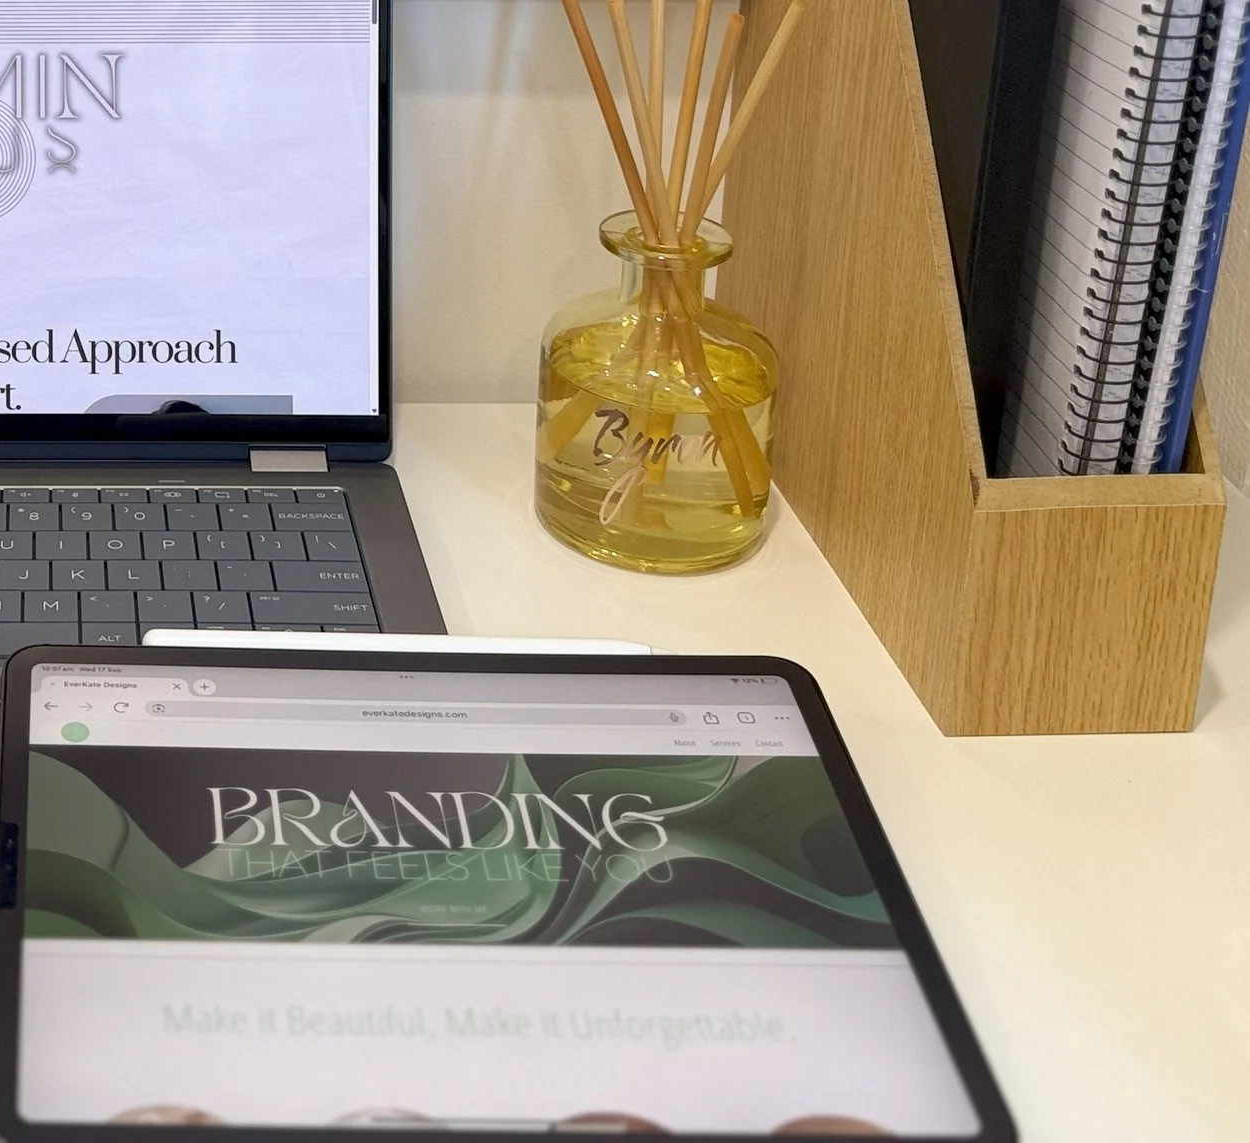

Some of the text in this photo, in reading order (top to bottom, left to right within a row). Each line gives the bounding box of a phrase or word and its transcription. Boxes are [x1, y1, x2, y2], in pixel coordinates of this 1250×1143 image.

[59, 328, 239, 375] Approach
[592, 408, 722, 525] Byron
[28, 512, 40, 521] 8
[81, 511, 93, 521] 9
[133, 511, 146, 521] 0
[0, 540, 14, 550] U
[107, 539, 124, 550] O
[162, 539, 175, 549] P
[18, 569, 29, 580] J
[71, 569, 85, 580] K
[128, 569, 140, 580] L
[319, 572, 360, 580] ENTER
[43, 600, 59, 611] M
[97, 634, 121, 642] ALT
[103, 681, 138, 690] Designs
[361, 709, 468, 719] everkatedesigns.com
[673, 738, 696, 747] About
[709, 739, 742, 748] Services
[754, 740, 784, 748] Contact
[206, 786, 669, 852] BRANDING
[213, 848, 675, 884] THAT FEELS LIKE YOU
[161, 1003, 800, 1050] Make it Beautiful, Make it Unforgettable.
